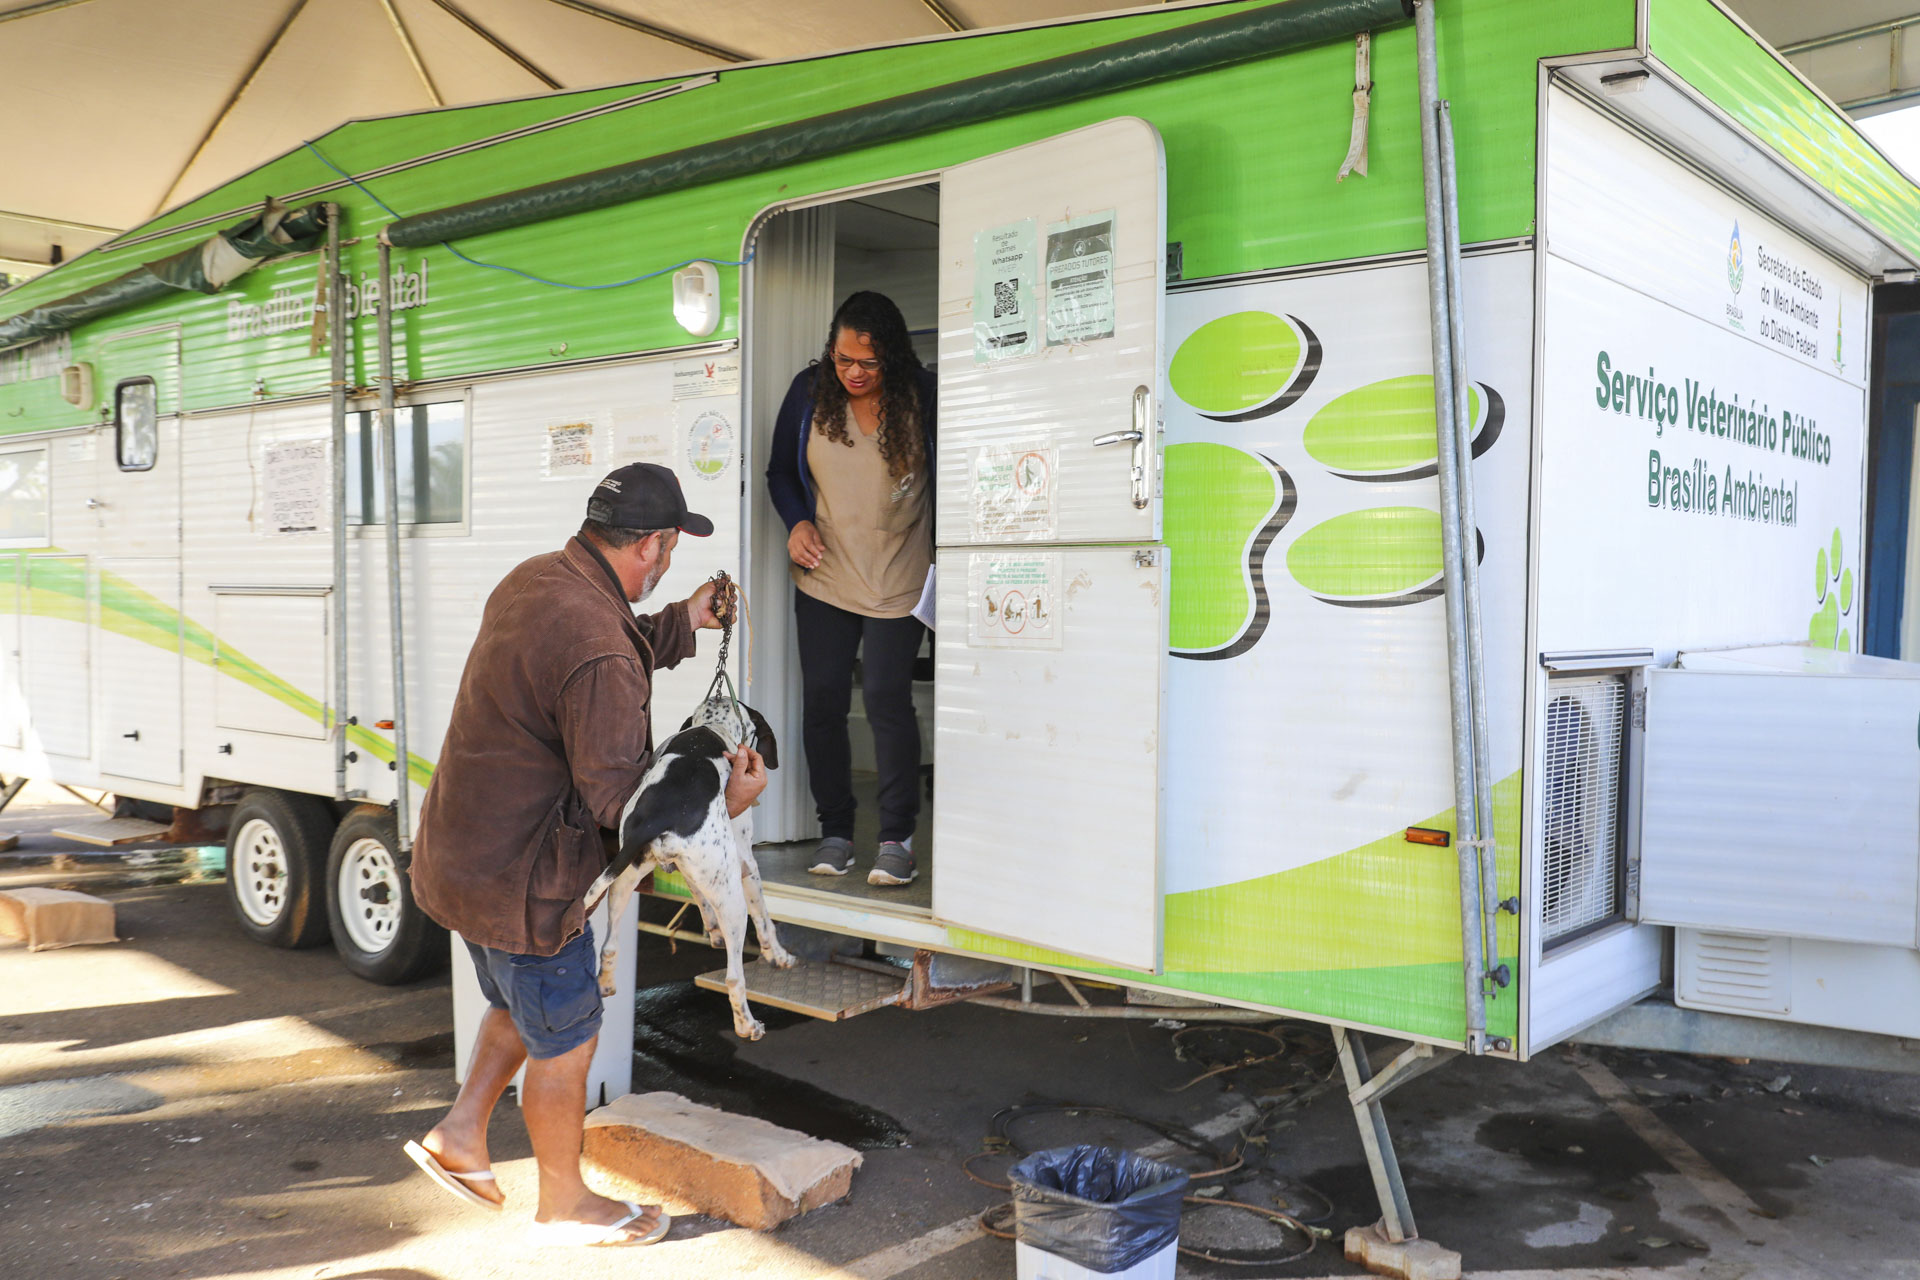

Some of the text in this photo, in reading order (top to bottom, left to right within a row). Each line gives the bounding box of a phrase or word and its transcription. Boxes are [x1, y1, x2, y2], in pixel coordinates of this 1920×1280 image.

[992, 253, 1023, 266] Whatsapp
[1049, 255, 1109, 275] PREZADOS TUTORES
[1758, 245, 1823, 301] Secretaria de Estado
[227, 289, 305, 342] Brasília
[1761, 281, 1819, 329] do Meio Ambiente
[1760, 315, 1769, 337] do
[1771, 319, 1795, 349] Distrito
[1796, 331, 1818, 359] Federal
[1596, 350, 1831, 466] Serviço Veterinário Público
[1648, 449, 1798, 527] Brasília Ambiental
